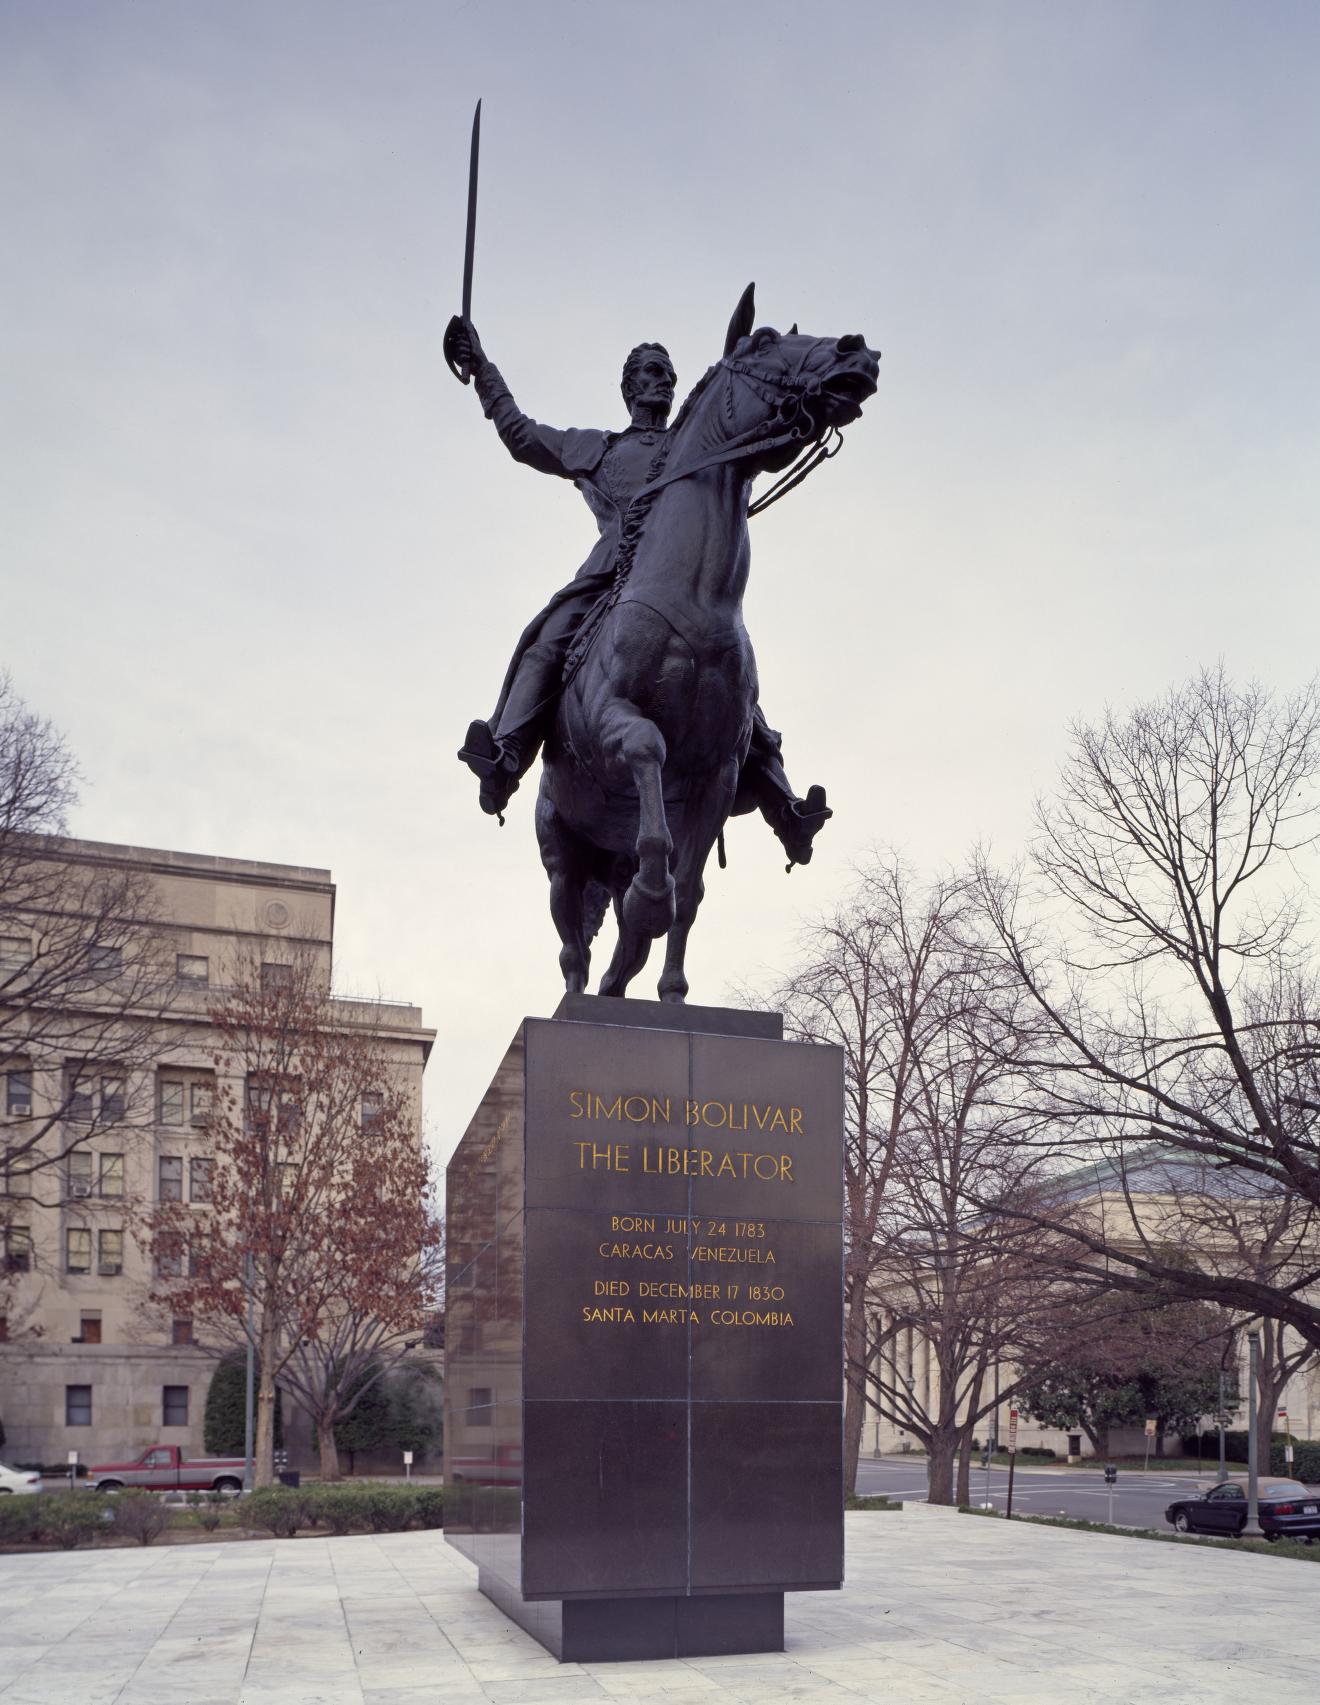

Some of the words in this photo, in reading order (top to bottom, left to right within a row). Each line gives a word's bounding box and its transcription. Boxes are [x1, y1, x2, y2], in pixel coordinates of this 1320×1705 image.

[569, 1091, 670, 1124] SIMON
[686, 1099, 803, 1134] BOLIVAR
[573, 1142, 630, 1172] THE
[643, 1146, 794, 1182] LIBERATOR
[611, 1216, 655, 1233] BORN
[664, 1219, 701, 1235] JULY
[707, 1221, 726, 1236] 24
[735, 1222, 765, 1238] 1783
[599, 1242, 674, 1260] CARACAS
[686, 1246, 776, 1264] VENEZUELA
[594, 1280, 630, 1297] DIED
[639, 1282, 721, 1300] DECEMBER
[727, 1285, 739, 1299] 17
[749, 1286, 785, 1301] 1830
[583, 1307, 635, 1324] SANTA
[643, 1309, 700, 1325] MARTA
[711, 1310, 794, 1326] COLOMBIA
